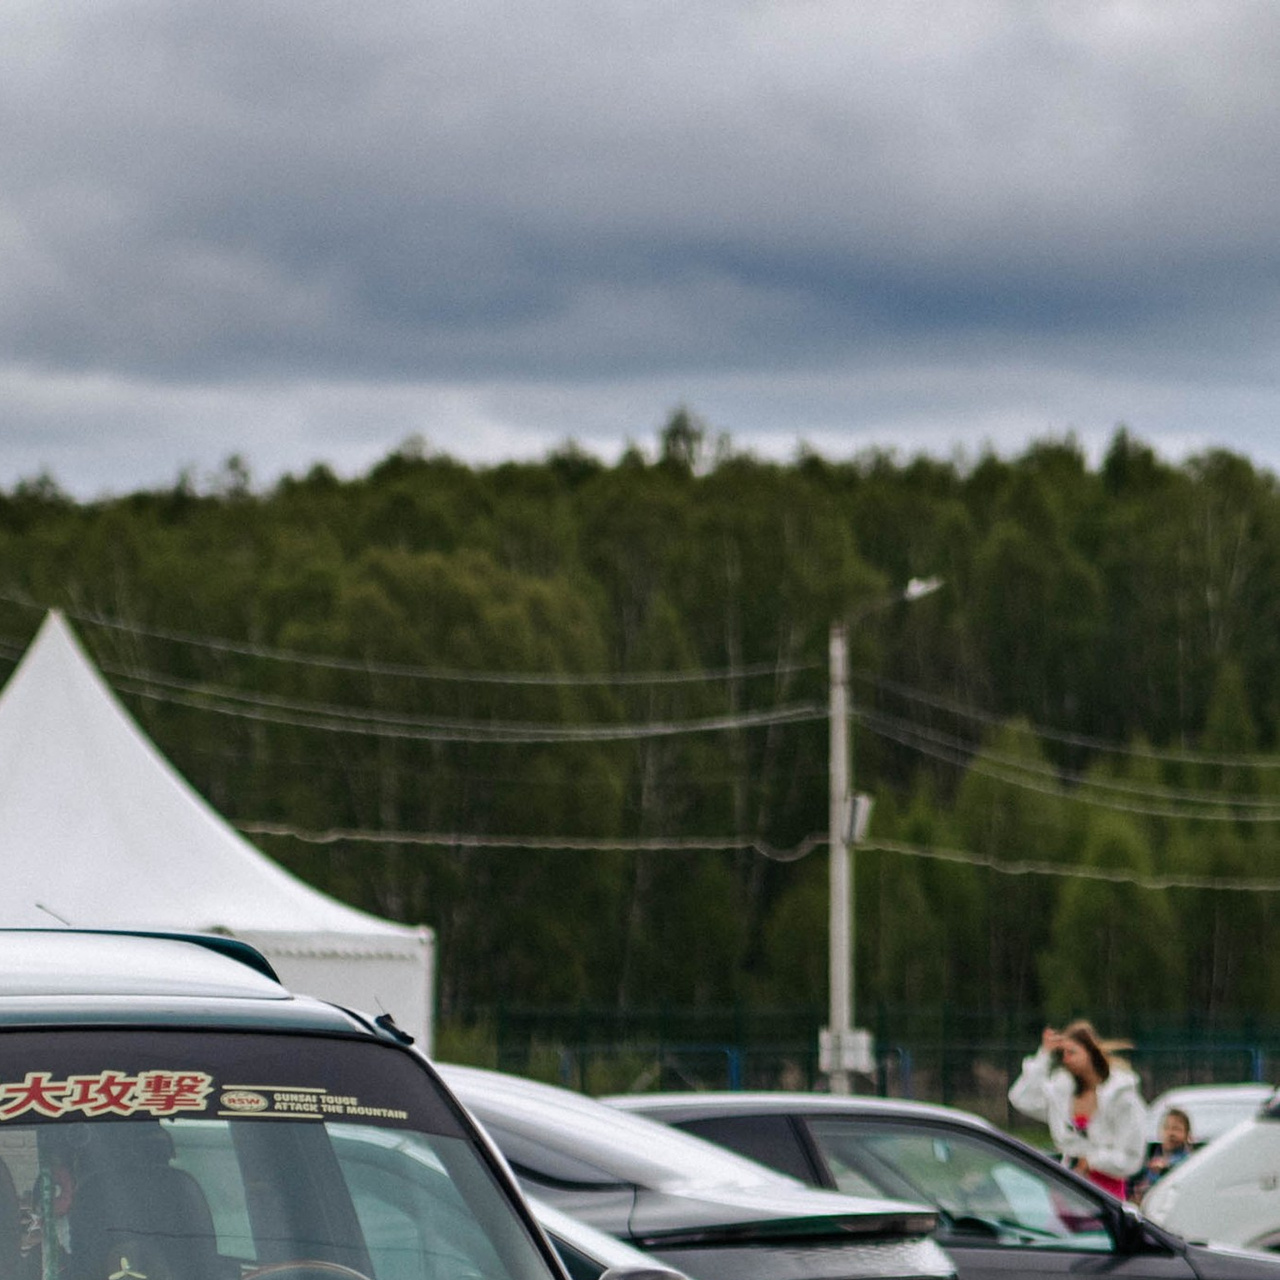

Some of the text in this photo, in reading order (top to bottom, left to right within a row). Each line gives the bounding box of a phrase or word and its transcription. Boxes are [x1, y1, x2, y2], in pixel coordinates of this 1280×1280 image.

[227, 1097, 261, 1105] RSW
[274, 1092, 358, 1106] GUNSAI TOUGE
[274, 1102, 408, 1119] ATTACK THE MOUNTAIN
